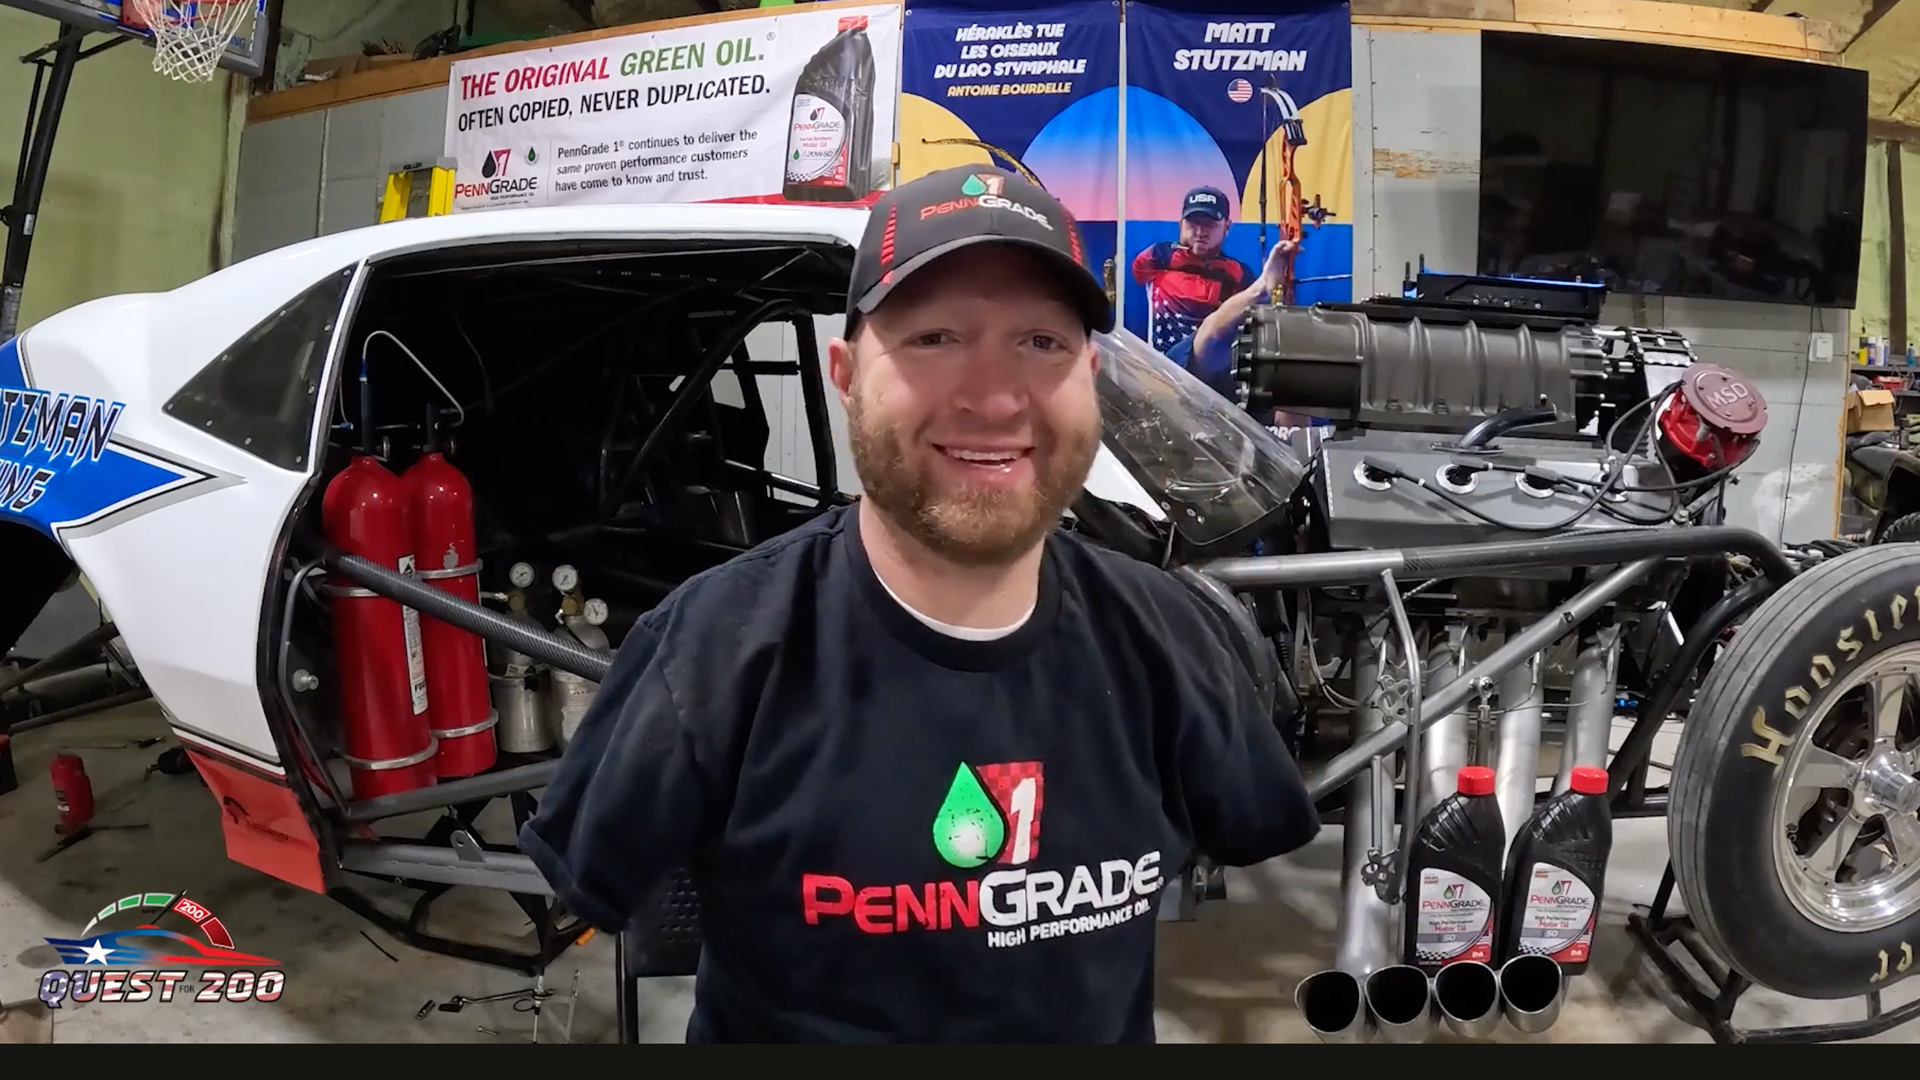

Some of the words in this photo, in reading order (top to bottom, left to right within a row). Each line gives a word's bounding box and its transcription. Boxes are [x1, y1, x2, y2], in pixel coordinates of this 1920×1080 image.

[955, 22, 1033, 42] HÉRAKLÈS
[1036, 23, 1066, 38] TUE
[1204, 22, 1276, 43] MATT
[960, 44, 989, 59] LES
[990, 42, 1061, 58] OISEAUX
[1173, 49, 1307, 71] STUTZMAN
[461, 72, 499, 100] THE
[504, 57, 610, 92] ORIGINAL
[620, 42, 705, 76] GREEN
[934, 64, 957, 79] DU
[957, 63, 991, 78] LAC
[993, 59, 1087, 77] STYMPHALE
[947, 83, 1000, 97] ANTOINE
[1000, 82, 1072, 95] BOURDELLE
[458, 106, 503, 131] OFTEN
[509, 97, 573, 123] COPIED,
[580, 88, 639, 114] NEVER
[647, 74, 770, 107] DUPLICATED.
[558, 143, 609, 159] PennGrade
[628, 136, 679, 150] continues
[683, 134, 694, 146] to
[698, 131, 735, 145] deliver
[739, 129, 758, 141] the
[556, 165, 581, 175] same
[584, 161, 616, 174] proven
[620, 155, 687, 171] performance
[690, 148, 748, 162] customers
[455, 177, 538, 198] PENNGRADE
[555, 180, 577, 192] have
[580, 179, 609, 190] come
[612, 175, 623, 187] to
[625, 173, 653, 186] know
[656, 170, 674, 183] and
[678, 168, 708, 182] trust.
[1189, 193, 1217, 204] USA
[920, 195, 1050, 228] PENNGRADE
[1706, 383, 1748, 410] MSD
[0, 388, 123, 469] TZMAN
[802, 851, 1161, 934] PENNGRADE
[1531, 895, 1589, 905] PENNGRADE
[1422, 899, 1484, 910] PENNGRADE
[987, 927, 1026, 948] HIGH
[1030, 904, 1132, 941] PERFORMANCE
[1134, 898, 1151, 916] OIL
